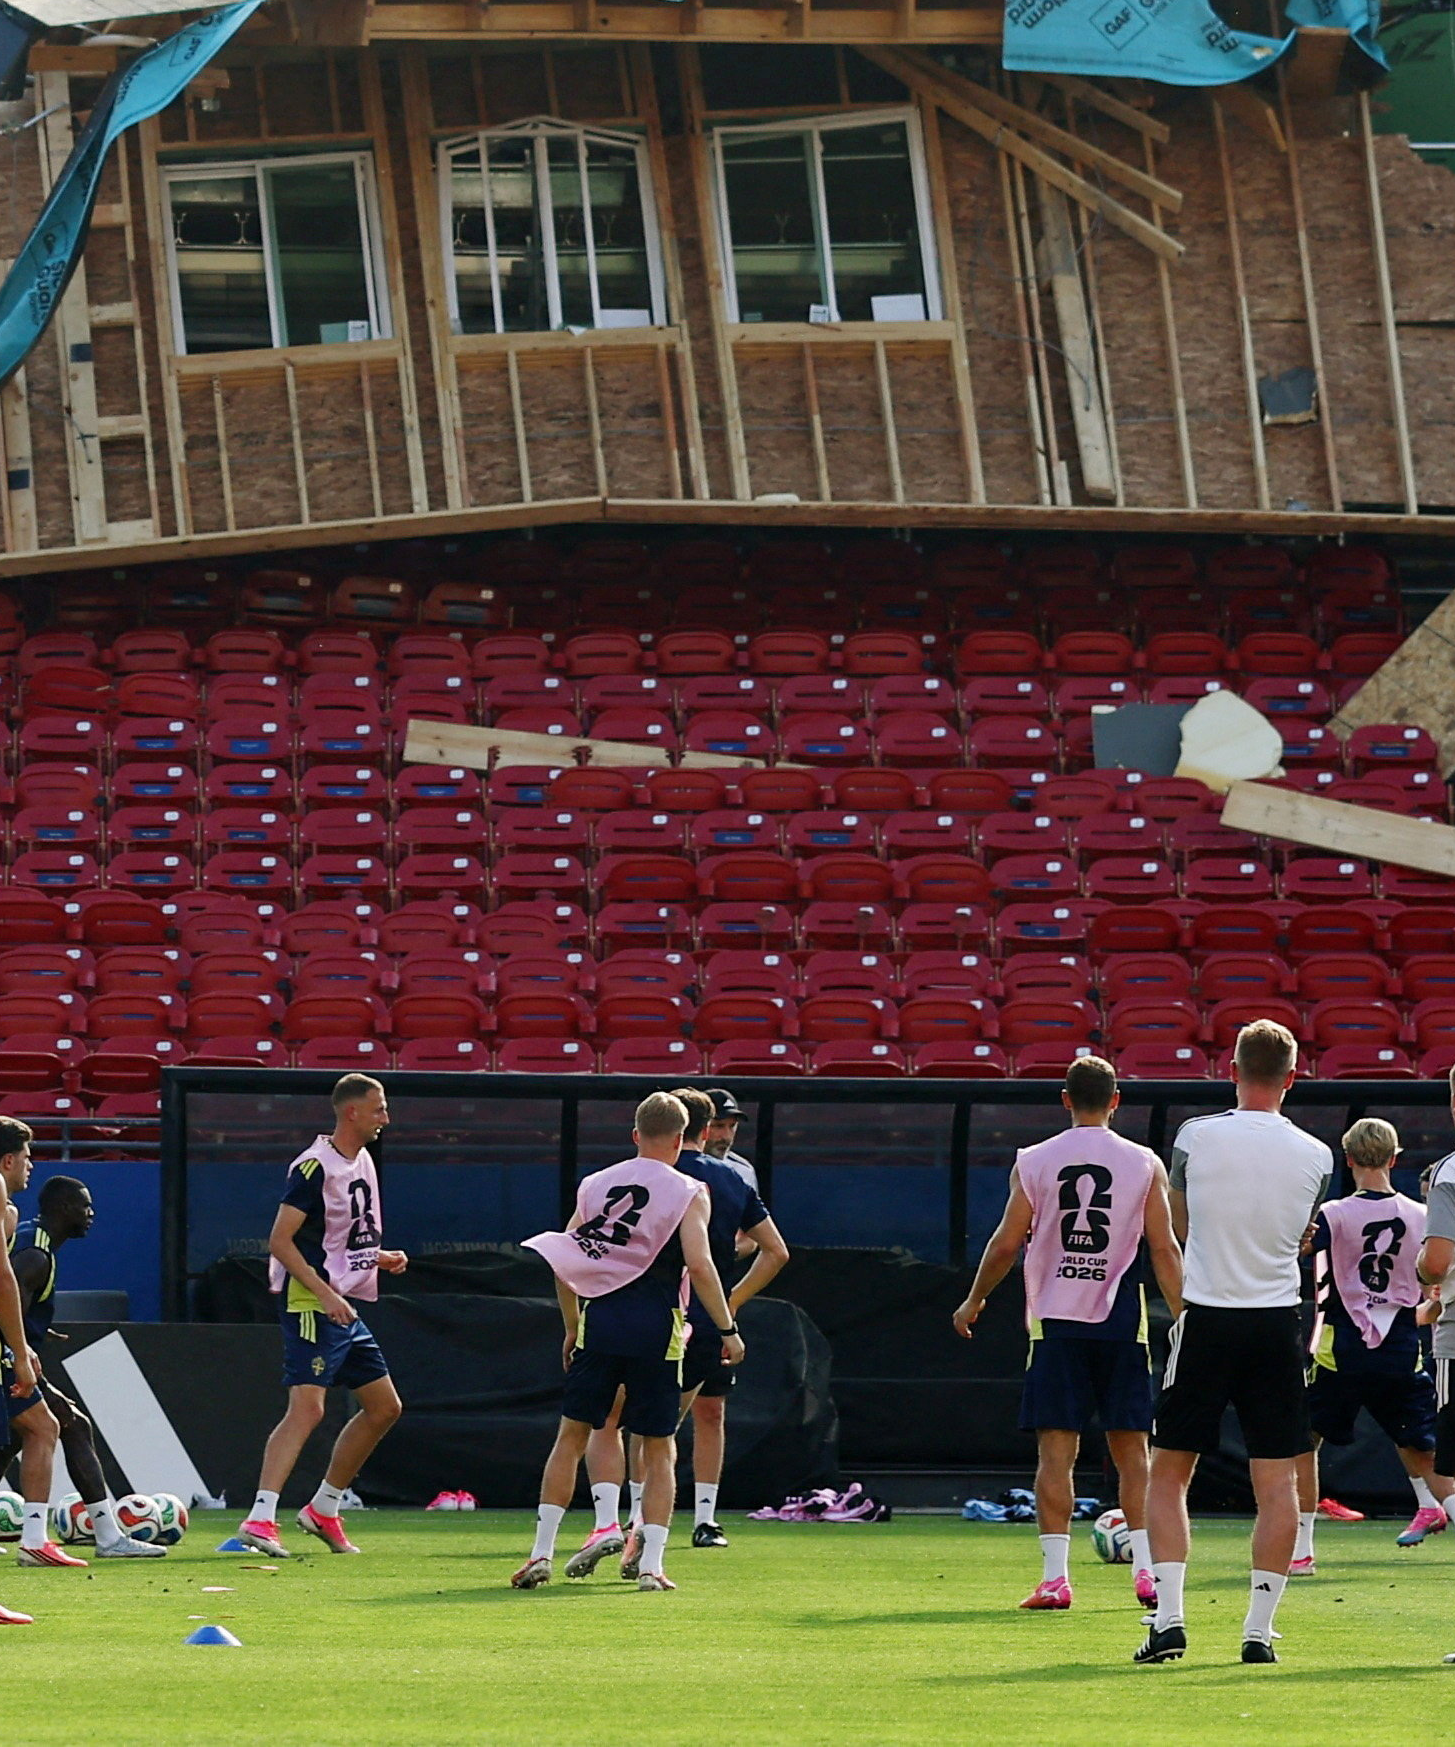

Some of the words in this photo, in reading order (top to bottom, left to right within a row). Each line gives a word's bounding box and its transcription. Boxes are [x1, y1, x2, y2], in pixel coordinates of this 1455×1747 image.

[1103, 6, 1133, 37] GAF
[1068, 1234, 1094, 1246] FIFA
[1087, 1257, 1108, 1267] CUP
